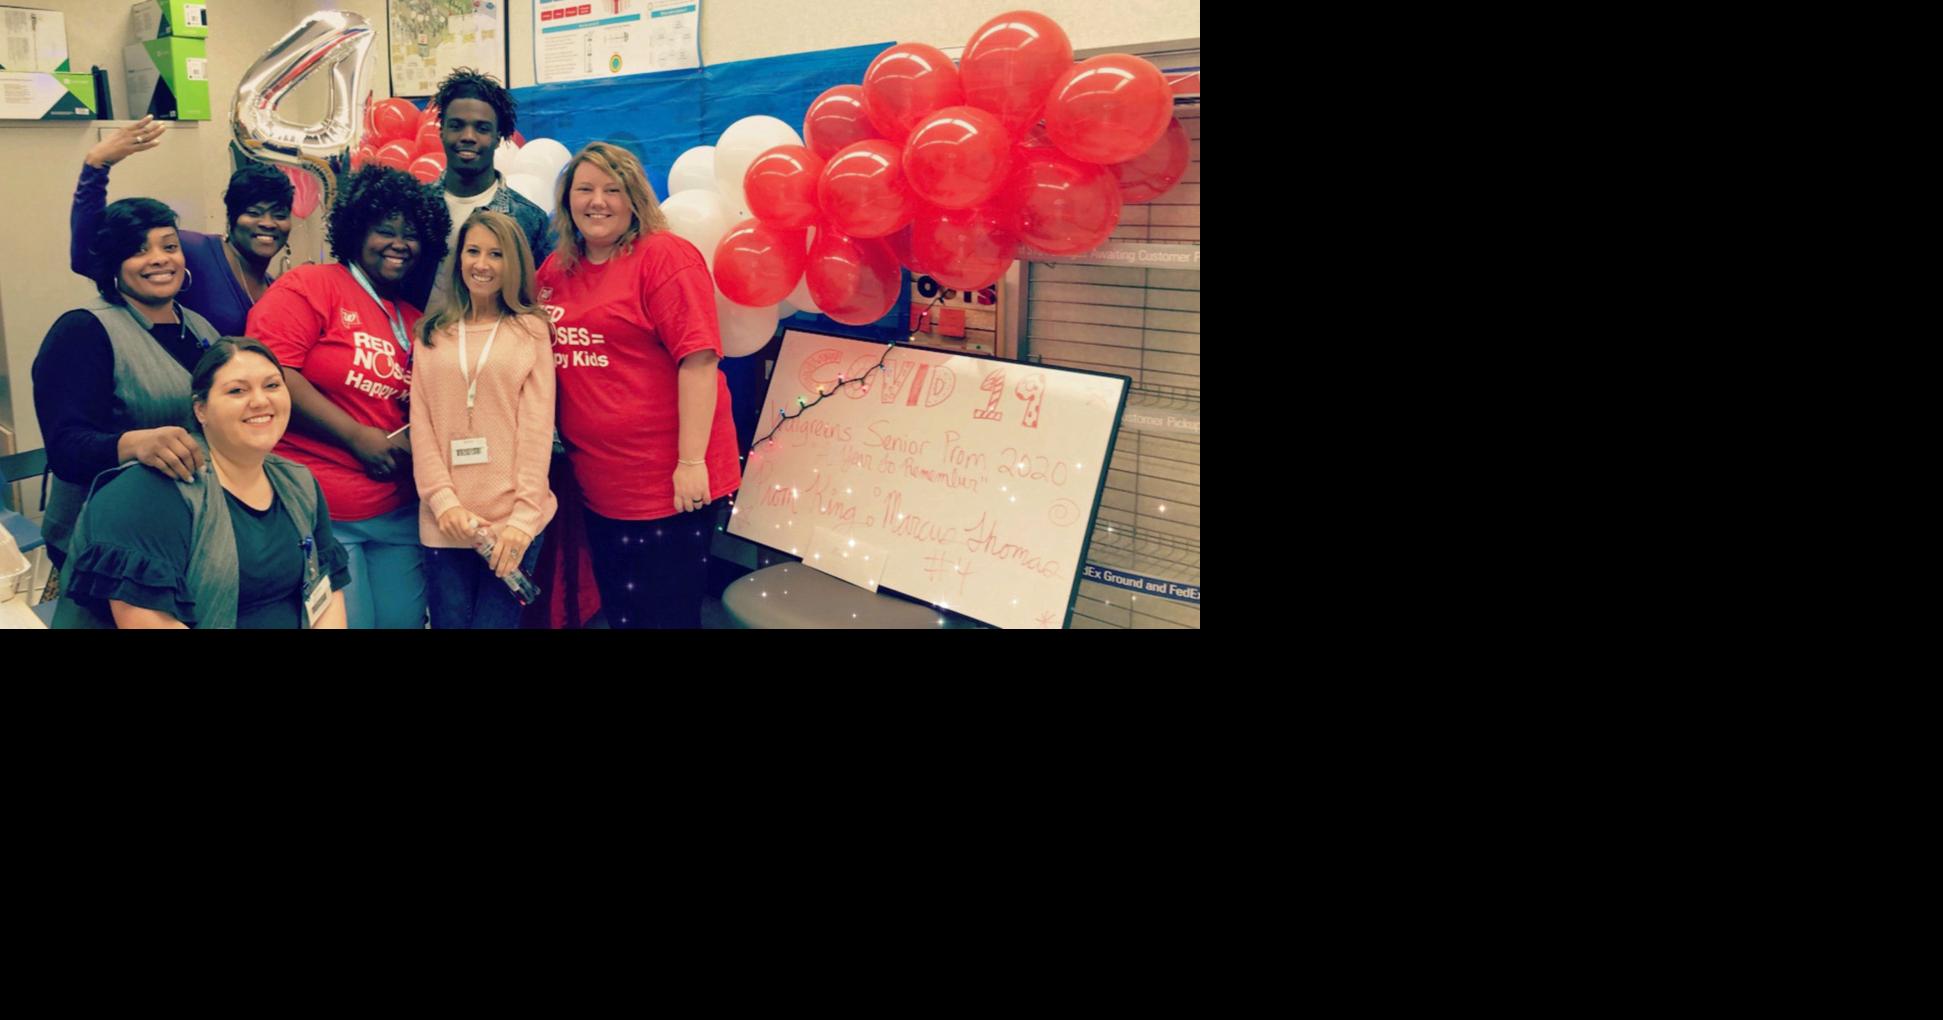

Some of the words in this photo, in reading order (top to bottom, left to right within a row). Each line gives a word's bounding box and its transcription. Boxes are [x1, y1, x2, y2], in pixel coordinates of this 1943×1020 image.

[1138, 250, 1190, 263] Customer
[353, 331, 396, 358] RED
[573, 350, 609, 368] Kids
[345, 369, 399, 400] Happy
[799, 348, 957, 408] COVID
[973, 367, 1046, 428] 19
[1122, 413, 1163, 427] ustomer
[863, 419, 931, 455] Senior
[944, 430, 986, 470] Prom
[998, 447, 1068, 486] 2020
[1083, 566, 1101, 579] dEx
[1103, 571, 1144, 589] Ground
[1145, 582, 1167, 594] and
